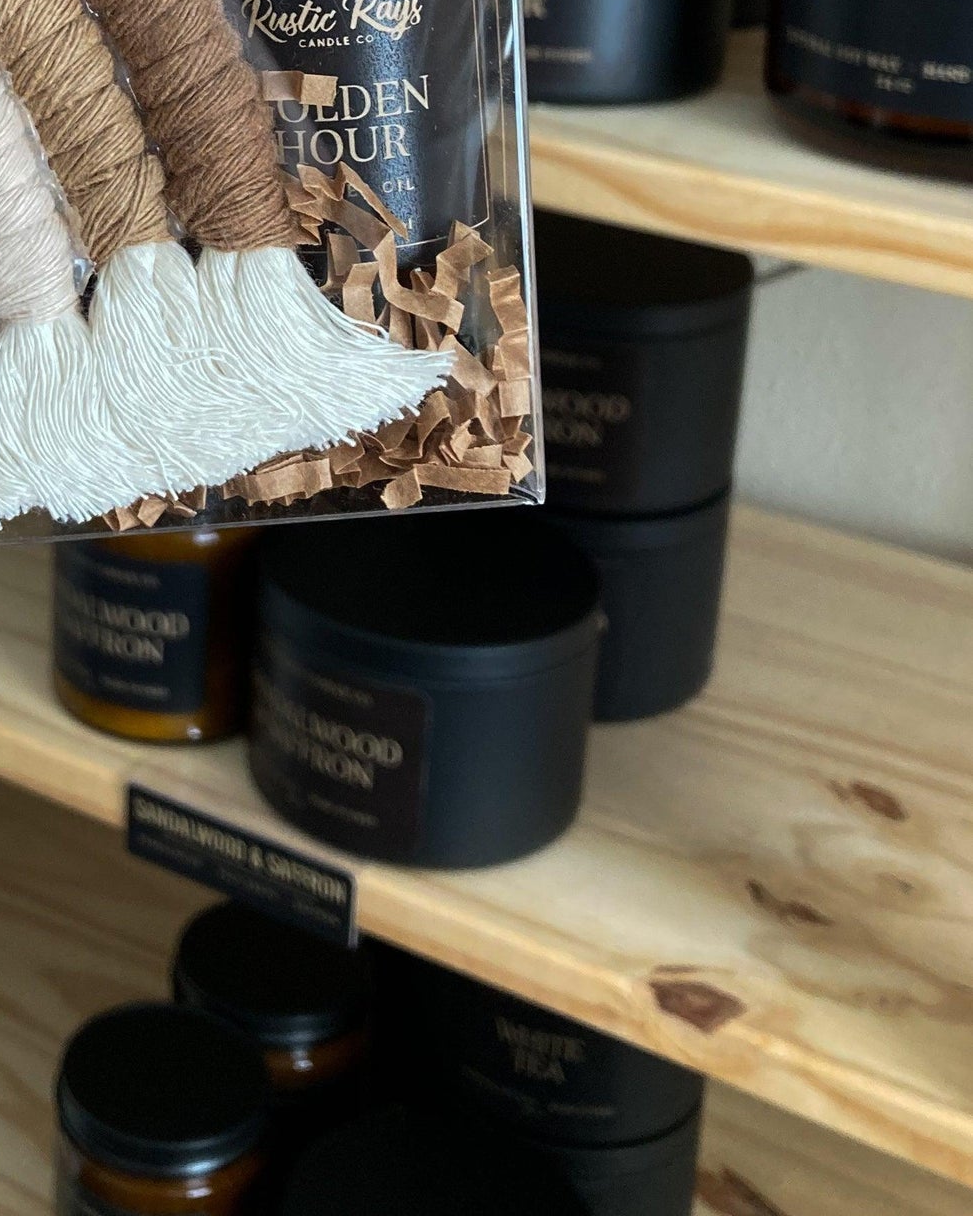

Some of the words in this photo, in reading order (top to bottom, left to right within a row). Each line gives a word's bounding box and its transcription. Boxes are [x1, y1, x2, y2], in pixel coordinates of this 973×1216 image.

[298, 35, 350, 48] CANDLE
[355, 34, 374, 44] CO
[276, 123, 411, 165] HOUR
[382, 180, 415, 193] OIL
